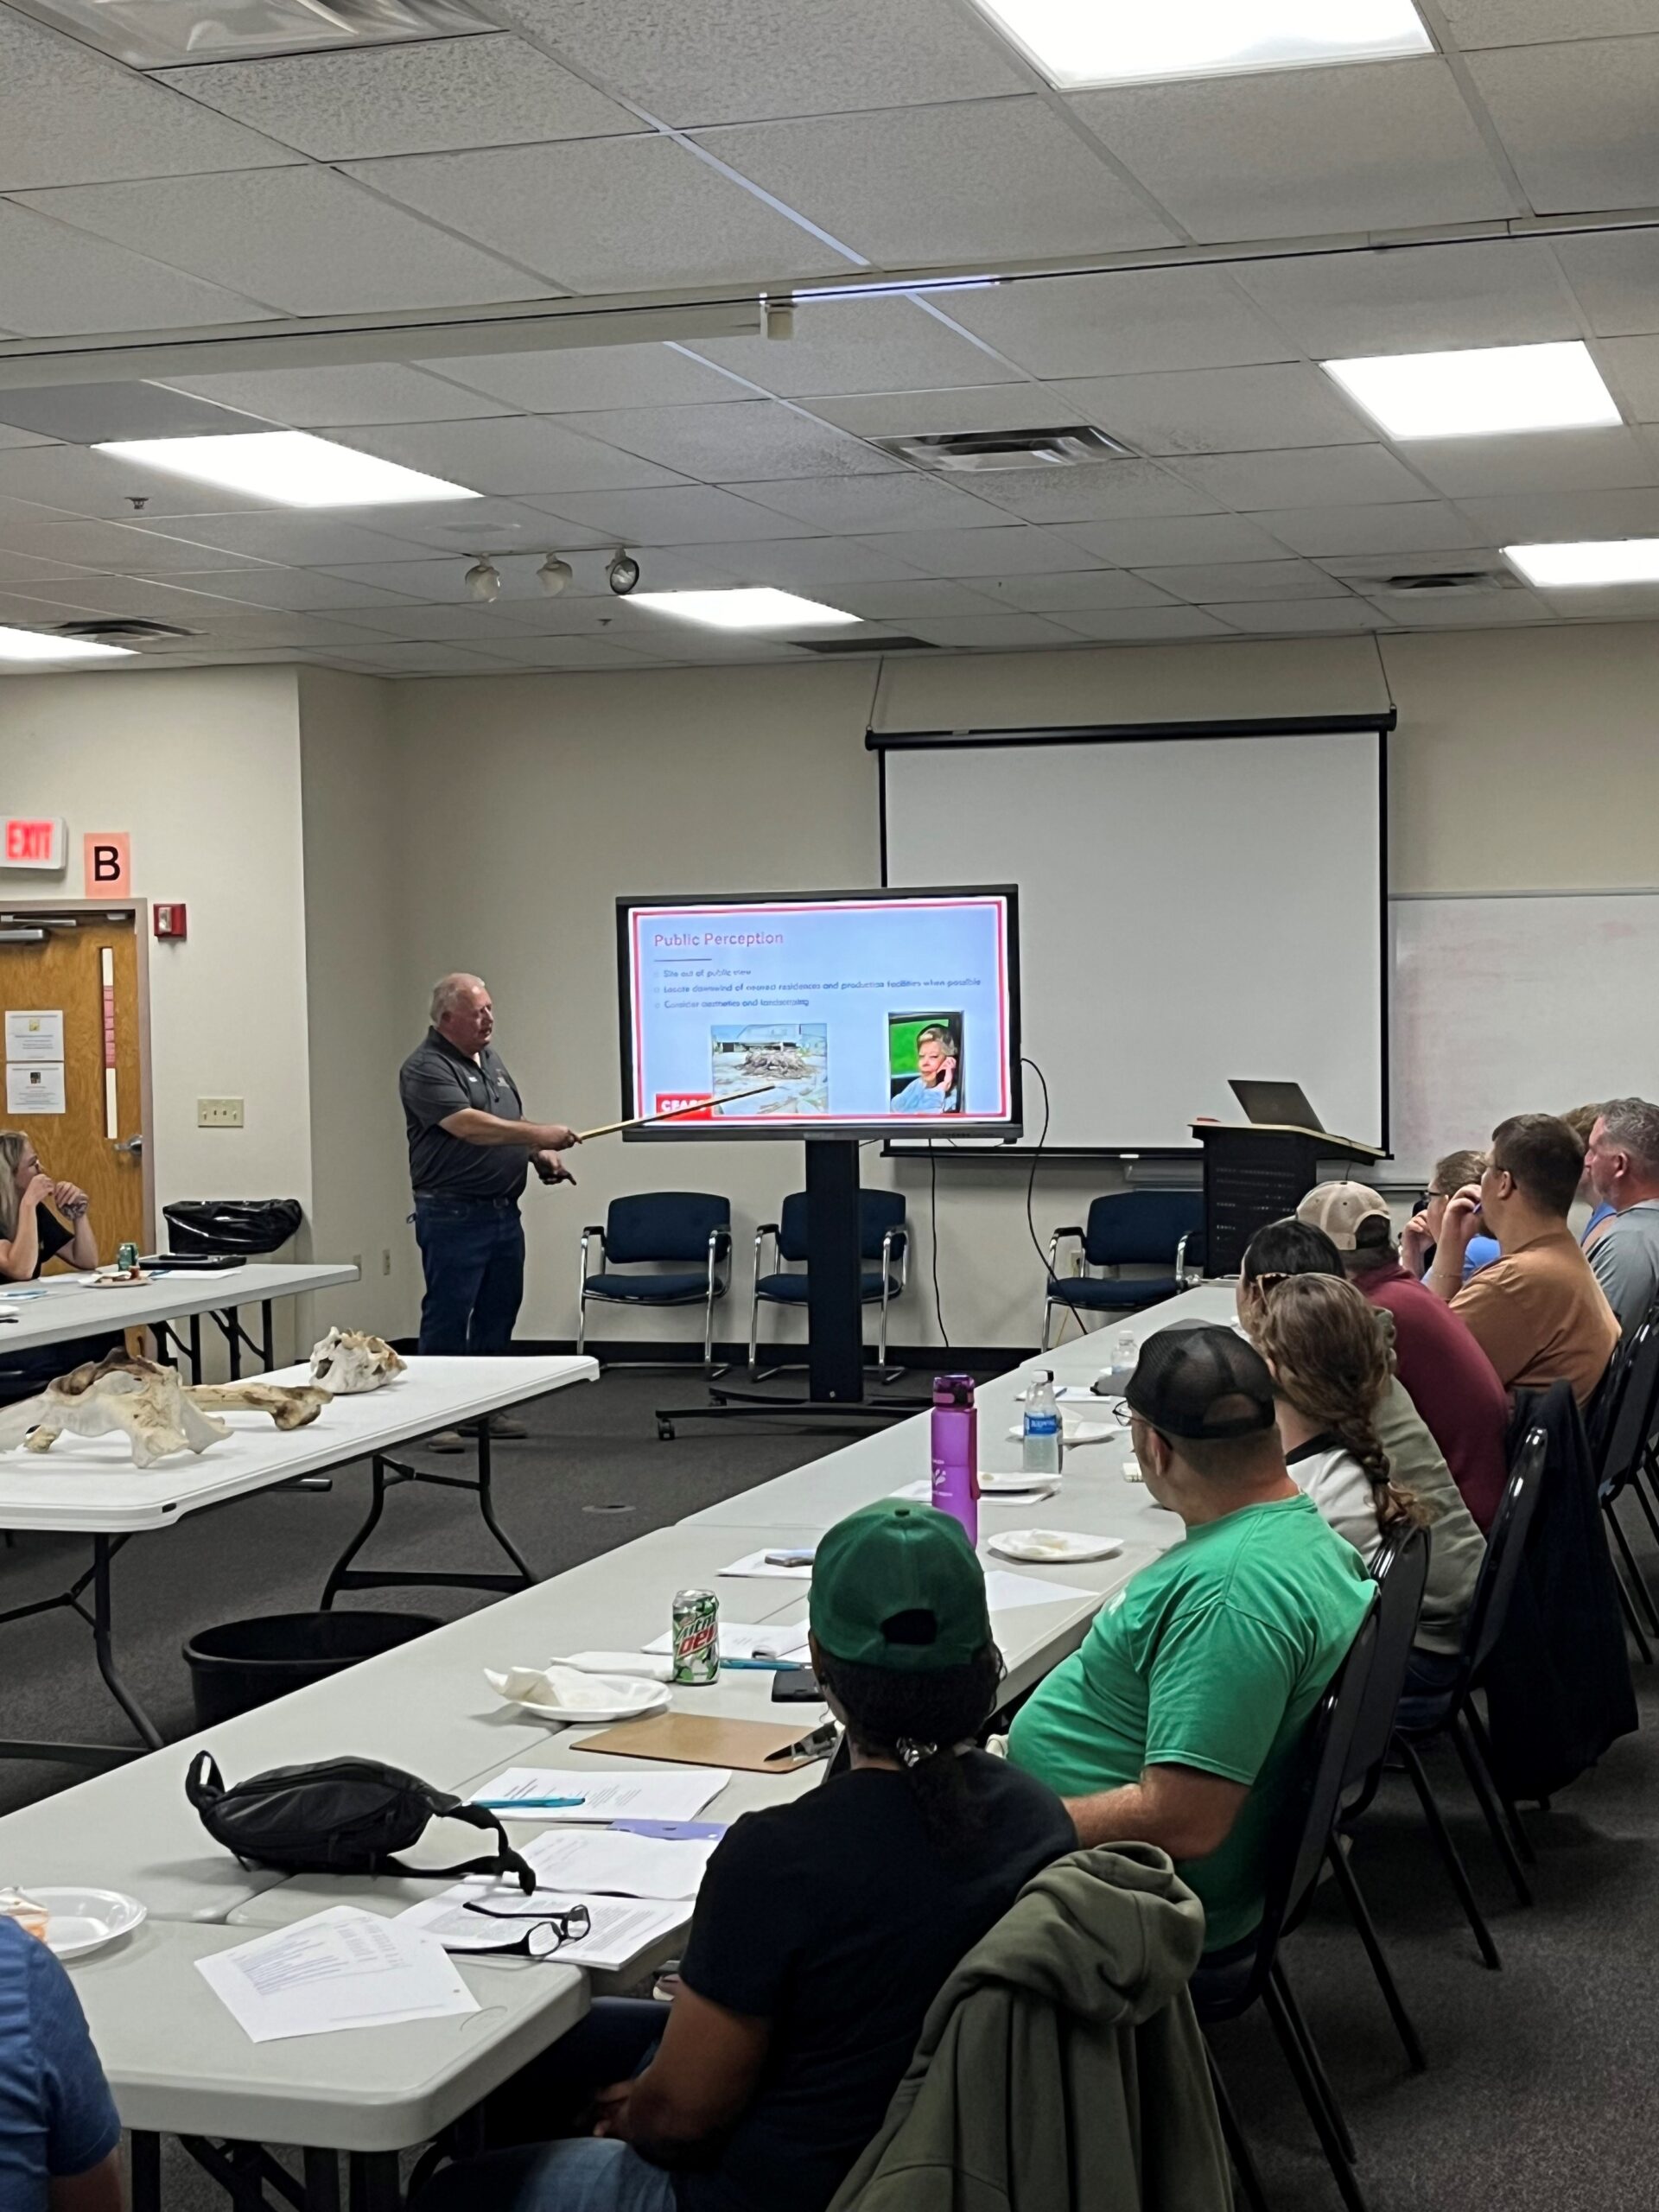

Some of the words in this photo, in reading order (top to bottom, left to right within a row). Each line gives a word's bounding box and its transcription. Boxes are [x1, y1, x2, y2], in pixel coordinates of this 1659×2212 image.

[7, 821, 53, 861] EXIT
[94, 846, 121, 881] B
[654, 933, 701, 947] Public
[704, 932, 785, 947] Perception
[696, 969, 704, 977] of
[707, 968, 731, 978] public
[734, 983, 744, 992] of
[742, 998, 758, 1007] and
